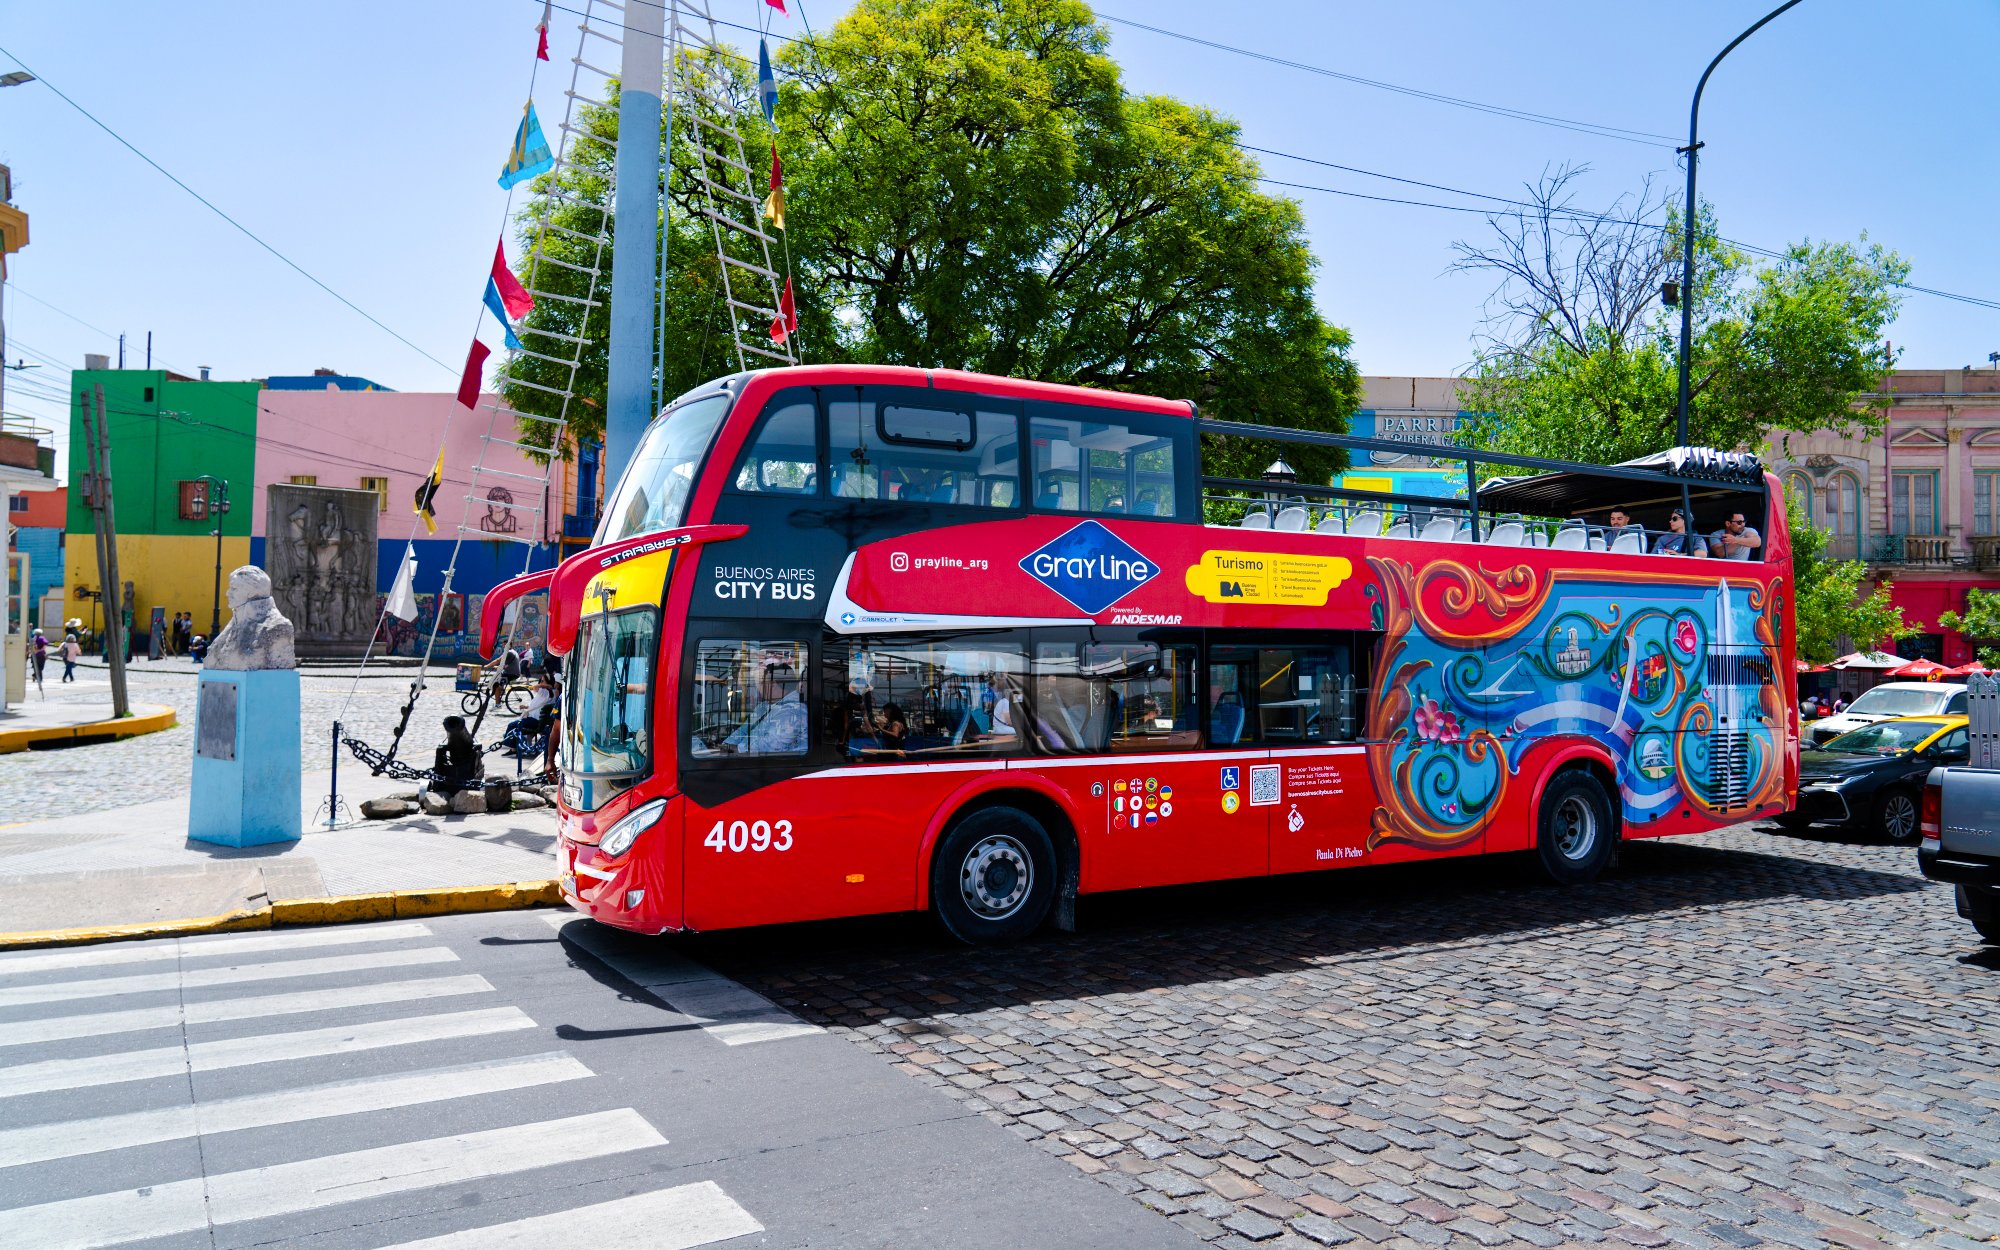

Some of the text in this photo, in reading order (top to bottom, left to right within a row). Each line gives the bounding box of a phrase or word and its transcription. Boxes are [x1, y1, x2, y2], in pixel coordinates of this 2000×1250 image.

[914, 557, 989, 570] grayline_arg
[1214, 556, 1263, 570] Turismo
[715, 566, 815, 581] BUENOS AIRES
[714, 581, 816, 600] CITY BUS
[1220, 581, 1244, 597] BA
[1111, 614, 1182, 625] ANDESMAR
[704, 819, 794, 853] 4093
[1316, 849, 1334, 861] Paula
[1335, 847, 1344, 859] Di
